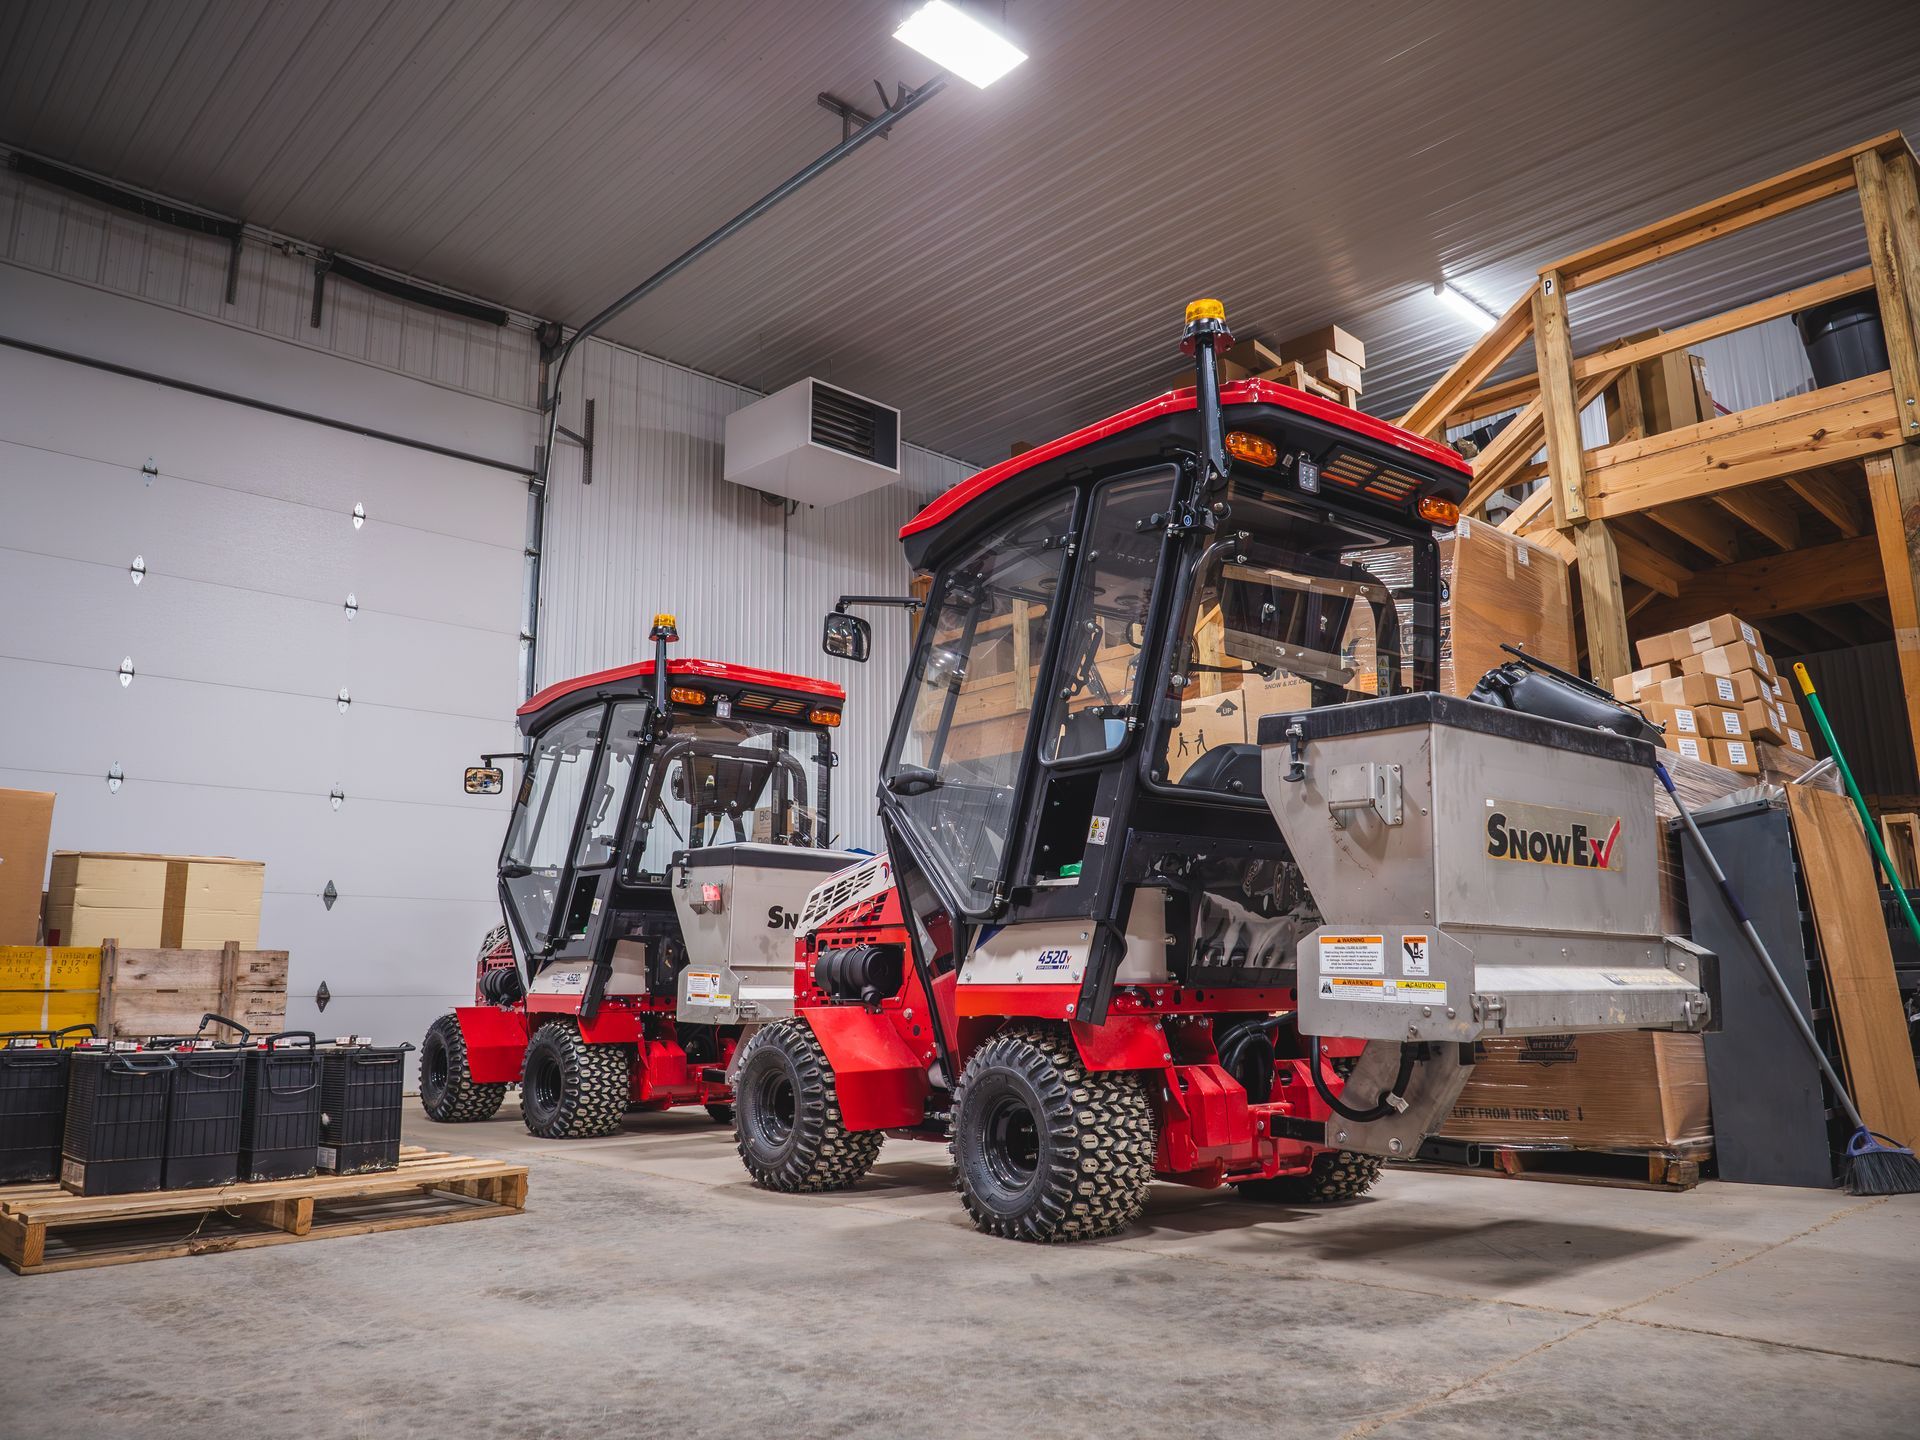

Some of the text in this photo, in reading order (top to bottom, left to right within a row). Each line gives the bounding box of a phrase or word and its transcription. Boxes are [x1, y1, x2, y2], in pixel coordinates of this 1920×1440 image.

[1545, 280, 1552, 295] P
[1222, 707, 1232, 715] UP
[1453, 1106, 1570, 1121] LIFT FROM THIS SIDE
